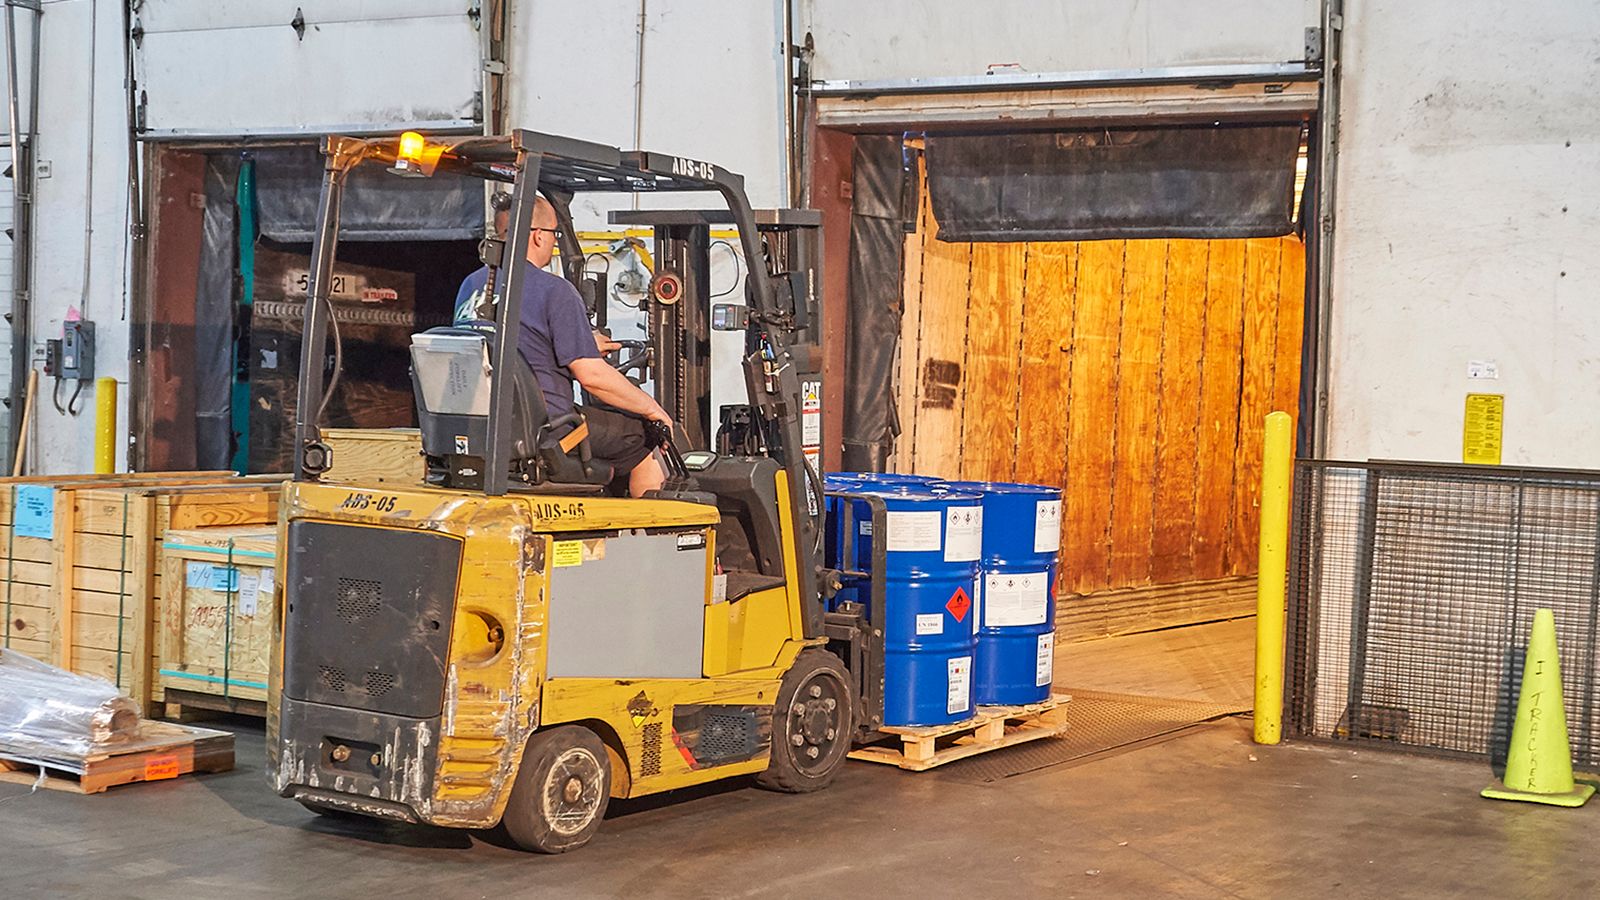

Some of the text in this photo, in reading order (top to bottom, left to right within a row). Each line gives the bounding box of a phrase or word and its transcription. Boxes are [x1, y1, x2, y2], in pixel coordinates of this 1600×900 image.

[672, 157, 714, 180] ADS-05
[802, 381, 820, 401] CAT
[341, 492, 397, 512] ADS-05
[534, 503, 585, 519] ADS-05
[1535, 660, 1544, 675] I
